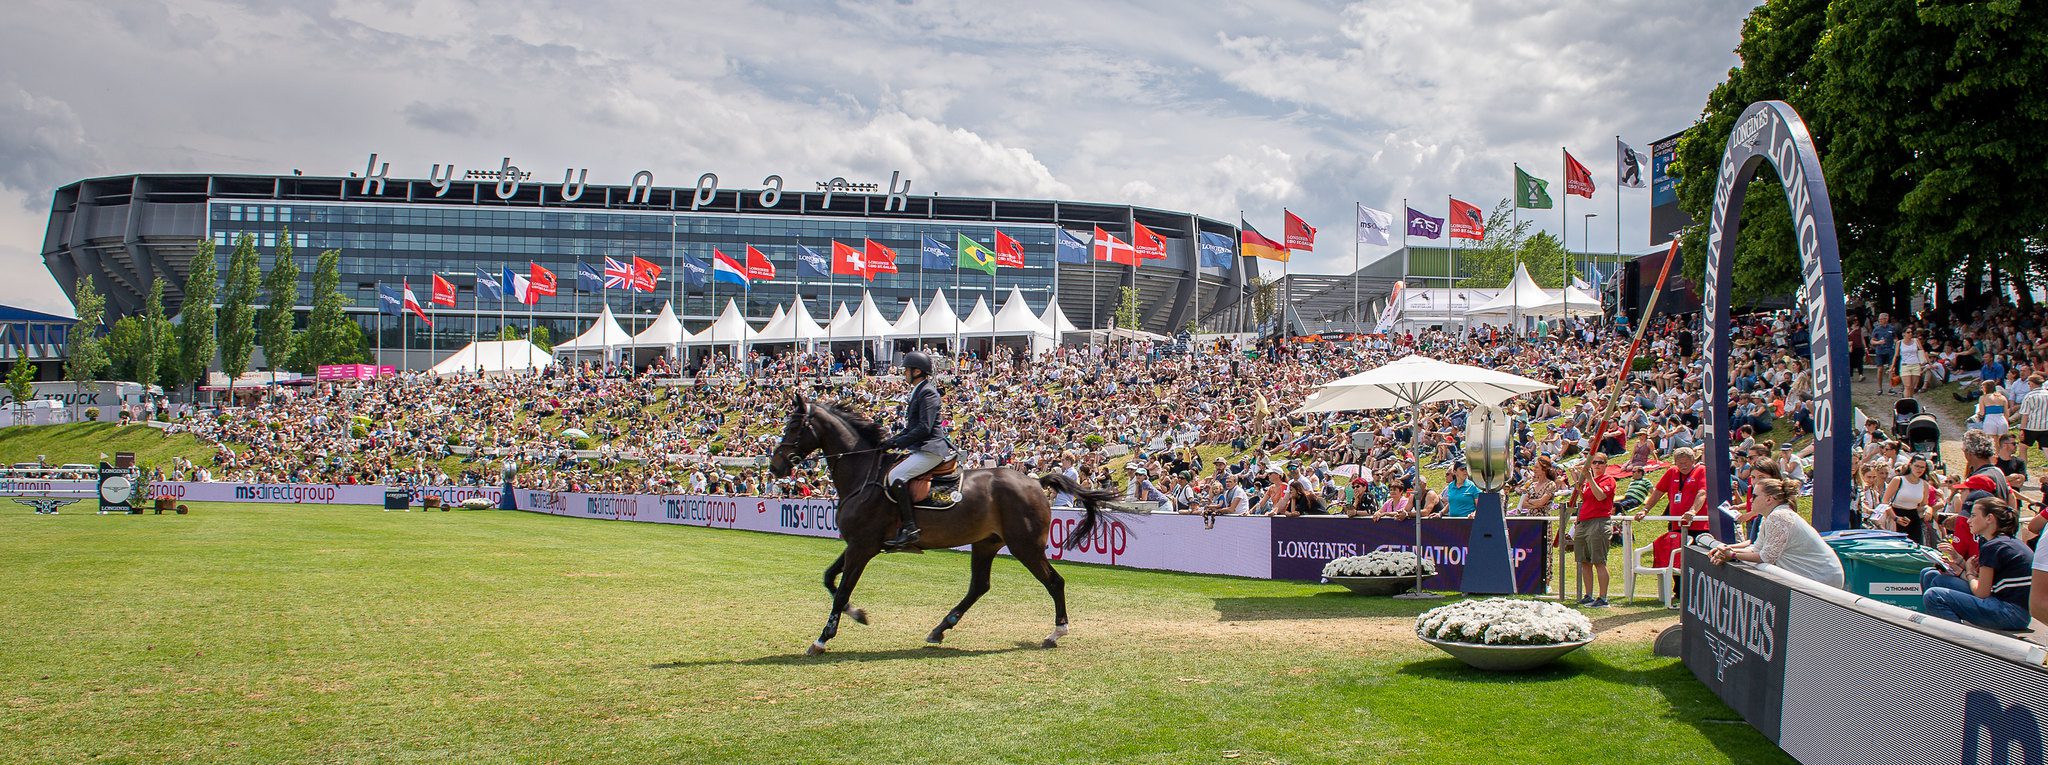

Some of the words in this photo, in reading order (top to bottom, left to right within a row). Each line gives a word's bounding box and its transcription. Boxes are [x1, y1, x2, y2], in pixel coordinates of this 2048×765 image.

[1732, 106, 1768, 148] LONGINES
[361, 153, 911, 212] kybunpark
[1703, 147, 1735, 440] LONGINES
[1768, 112, 1832, 441] LONGINES
[1278, 540, 1357, 560] LONGINES
[1687, 566, 1776, 662] LONGINES
